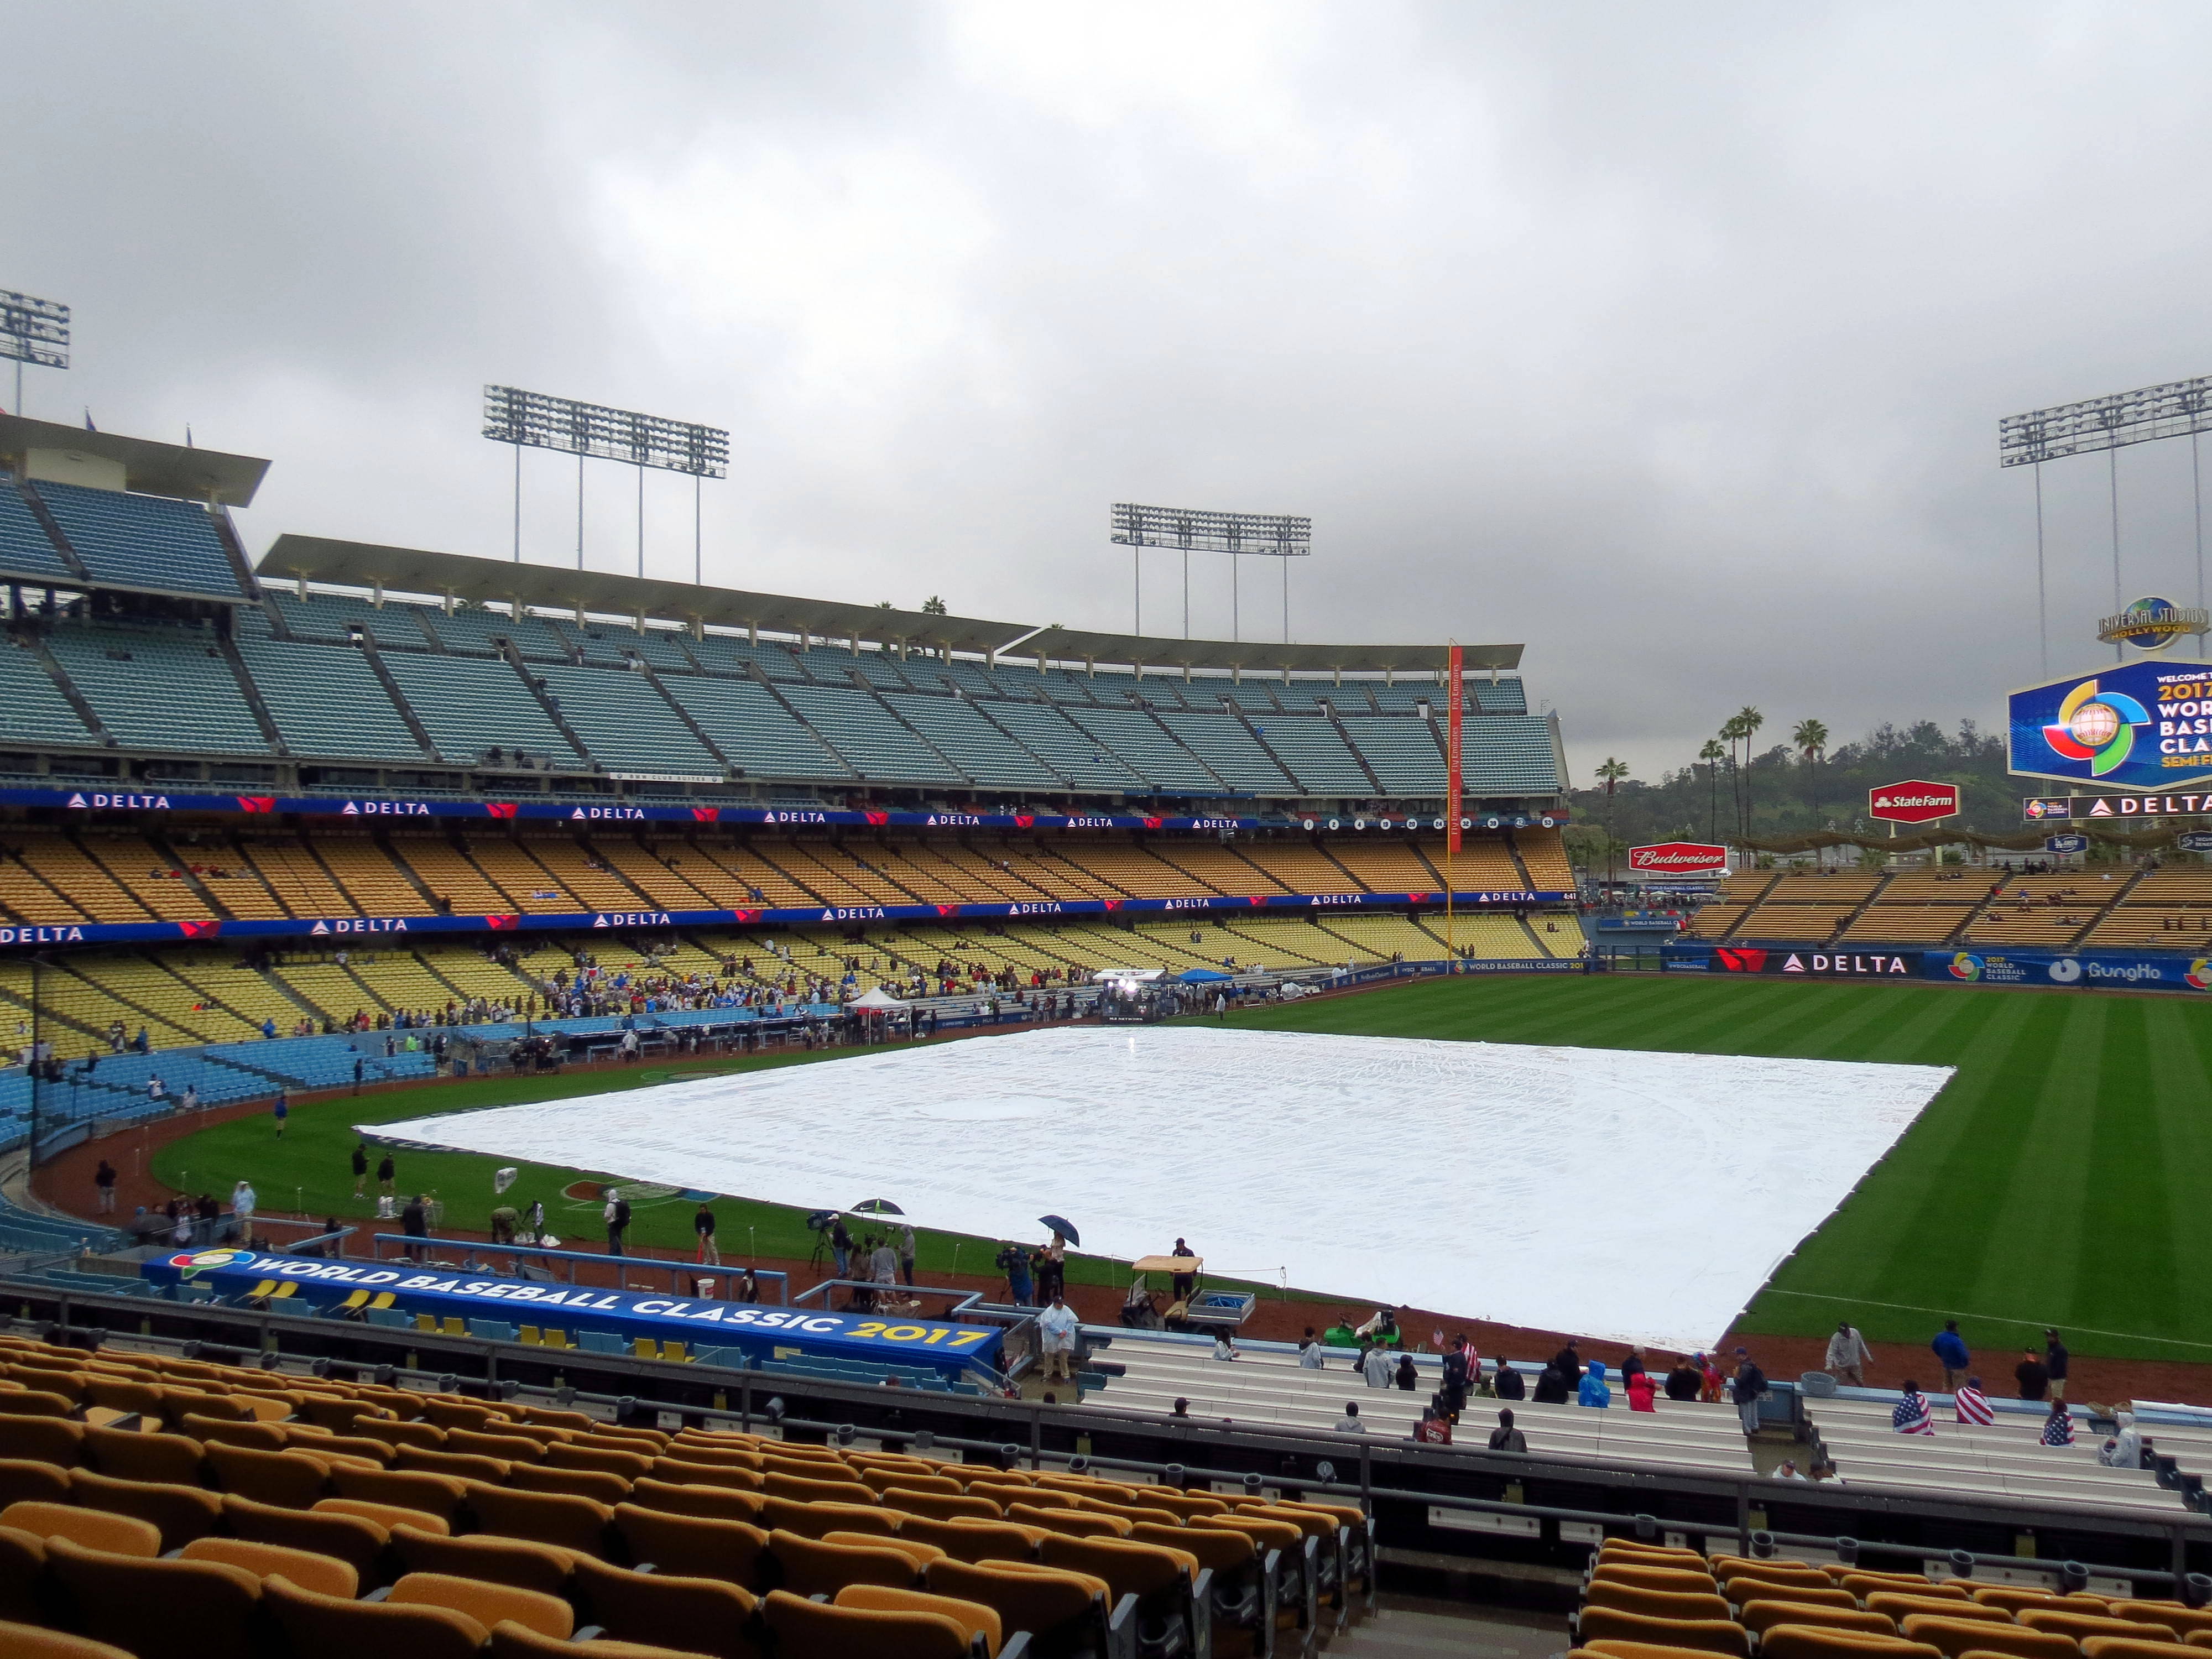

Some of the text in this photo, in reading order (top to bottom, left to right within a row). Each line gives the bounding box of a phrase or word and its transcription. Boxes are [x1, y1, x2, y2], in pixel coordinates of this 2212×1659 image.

[2098, 608, 2205, 635] UNIVERSAL STUDIOS
[2111, 625, 2190, 640] HOLLYWOOD
[2157, 672, 2207, 683] WELCOME
[2158, 681, 2212, 701] 2017
[2160, 737, 2212, 754] CLA
[95, 795, 170, 808] DELTA
[2121, 795, 2212, 813] DELTA
[366, 802, 429, 815] DELTA
[591, 807, 644, 819] DELTA
[780, 812, 825, 822] DELTA
[941, 815, 979, 825] DELTA
[1079, 818, 1113, 827] DELTA
[1204, 819, 1238, 828] DELTA
[1634, 851, 1723, 866] Budweiser
[1176, 898, 1209, 907] DELTA
[1323, 895, 1361, 904] DELTA
[1492, 891, 1535, 901] DELTA
[838, 907, 884, 919] DELTA
[1022, 903, 1061, 913] DELTA
[336, 919, 408, 932] DELTA
[613, 913, 670, 925] DELTA
[0, 927, 84, 944] DELTA
[1813, 954, 1907, 973] DELTA
[2089, 962, 2161, 982] GungHo
[248, 1258, 990, 1346] WORLD BASEBALL CLASSIC 2017
